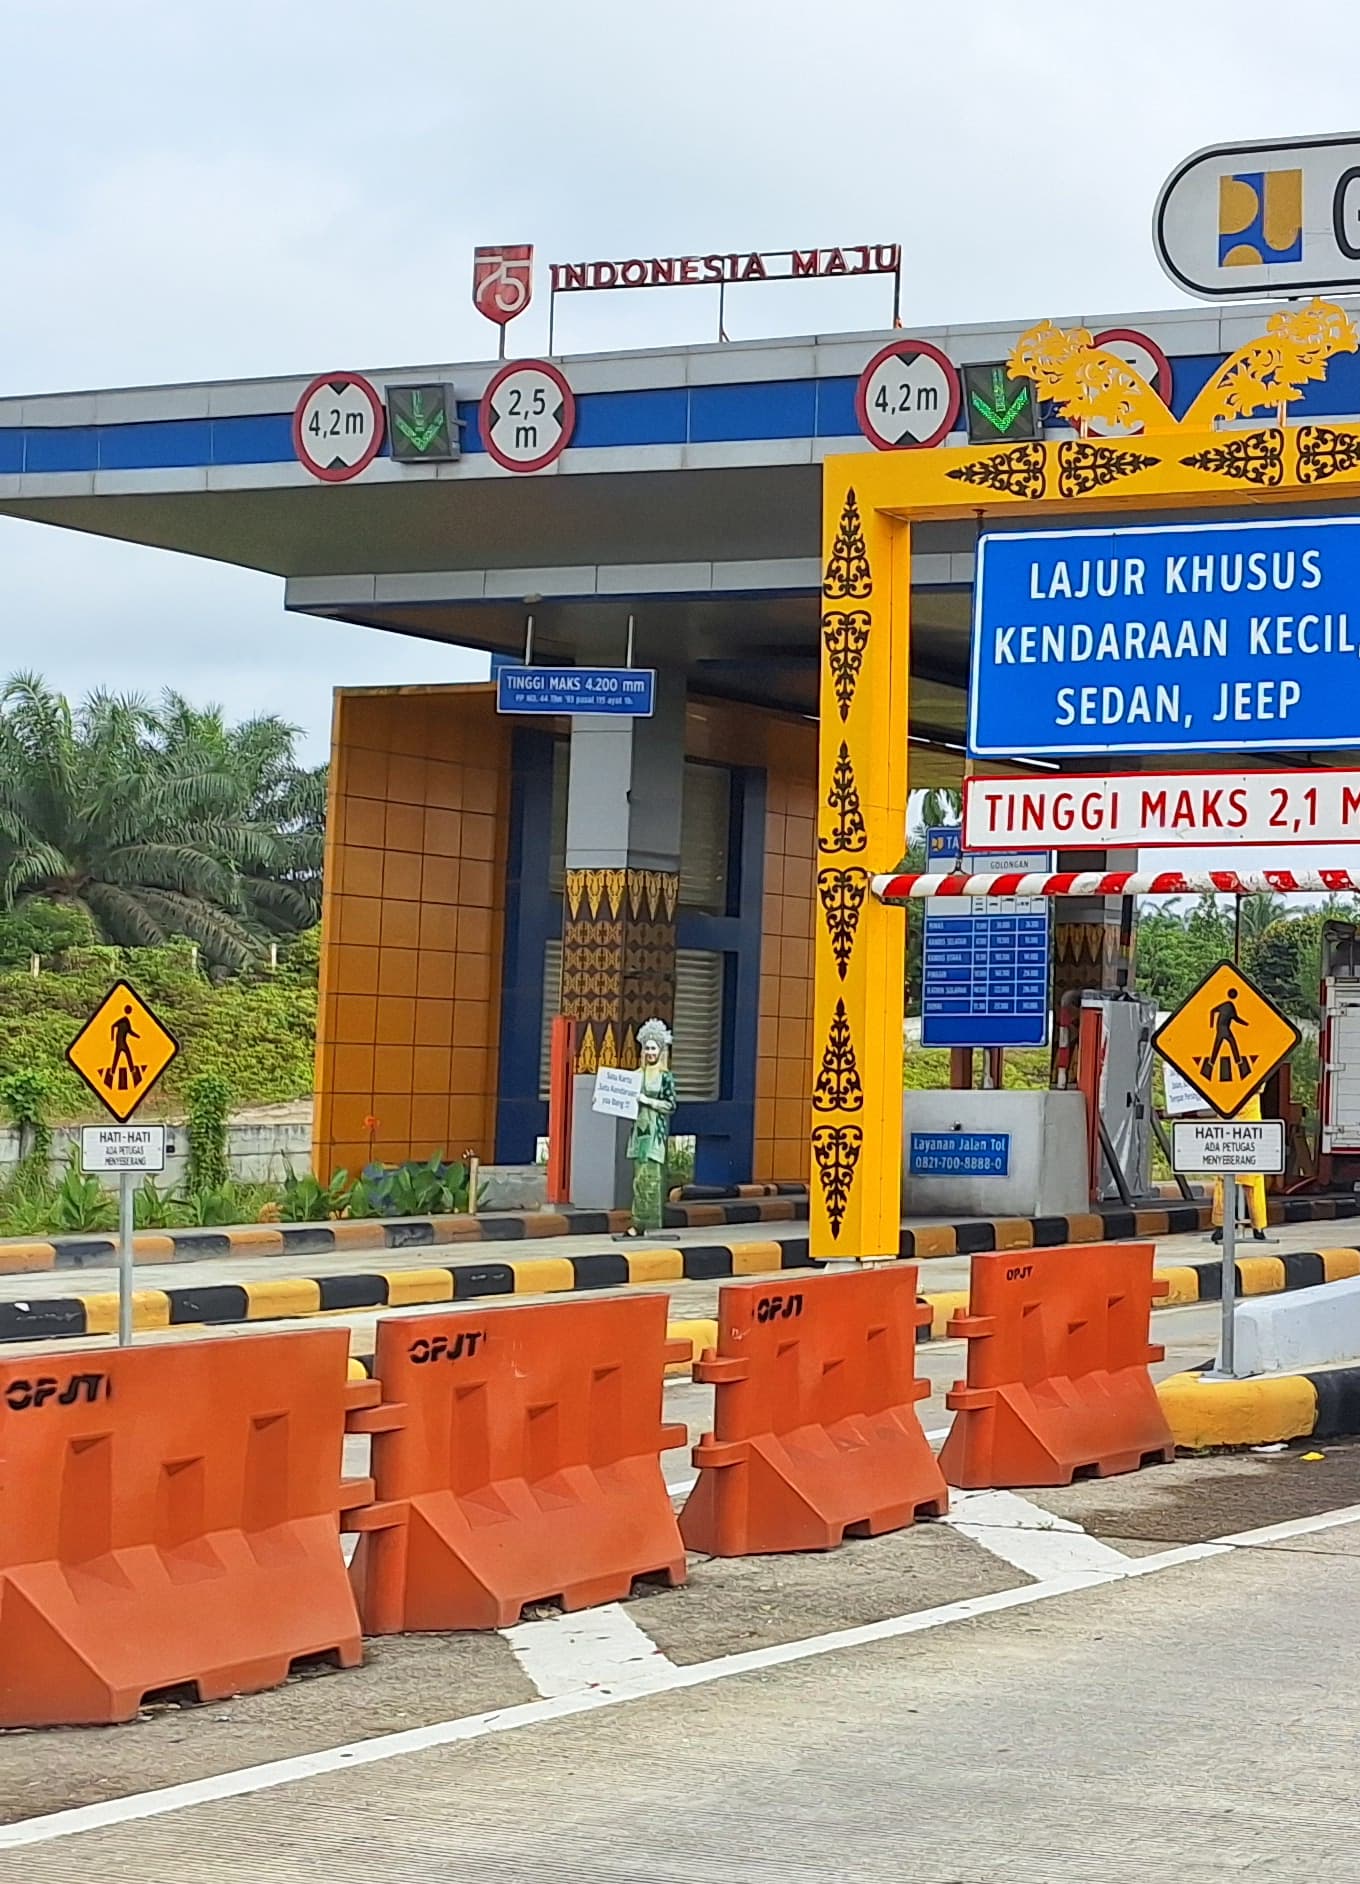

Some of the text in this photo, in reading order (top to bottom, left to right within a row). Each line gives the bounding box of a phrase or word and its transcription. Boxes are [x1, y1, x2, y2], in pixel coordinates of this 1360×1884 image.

[549, 244, 901, 289] INDONESIA MAJU
[475, 256, 531, 311] 75
[508, 388, 546, 421] 2,5
[515, 425, 538, 448] m
[1030, 549, 1322, 599] LAJUR KHUSUS
[993, 618, 1228, 665] KENDARAAN
[507, 675, 645, 693] TINGGI MAKS 4.200 mm
[1054, 680, 1301, 729] SEDAN, JEEP
[984, 791, 1118, 832] TINGGI
[1140, 788, 1248, 829] MAKS
[1268, 787, 1317, 833] 2,1
[990, 860, 1028, 869] GOLONGAN
[99, 1131, 151, 1143] HATI-HATI
[1195, 1127, 1263, 1139] HATI-HATI
[119, 1146, 144, 1155] PETUGAS
[913, 1137, 1005, 1153] Layanan Jalan Tol
[1204, 1142, 1255, 1152] ADA PETUGAS
[105, 1156, 146, 1166] MENYEBERANG
[915, 1156, 1002, 1169] 0821-700-8888-0
[1202, 1155, 1256, 1165] MENYEBERANG
[1006, 1265, 1033, 1281] OPJT
[757, 1294, 803, 1323] OPJT
